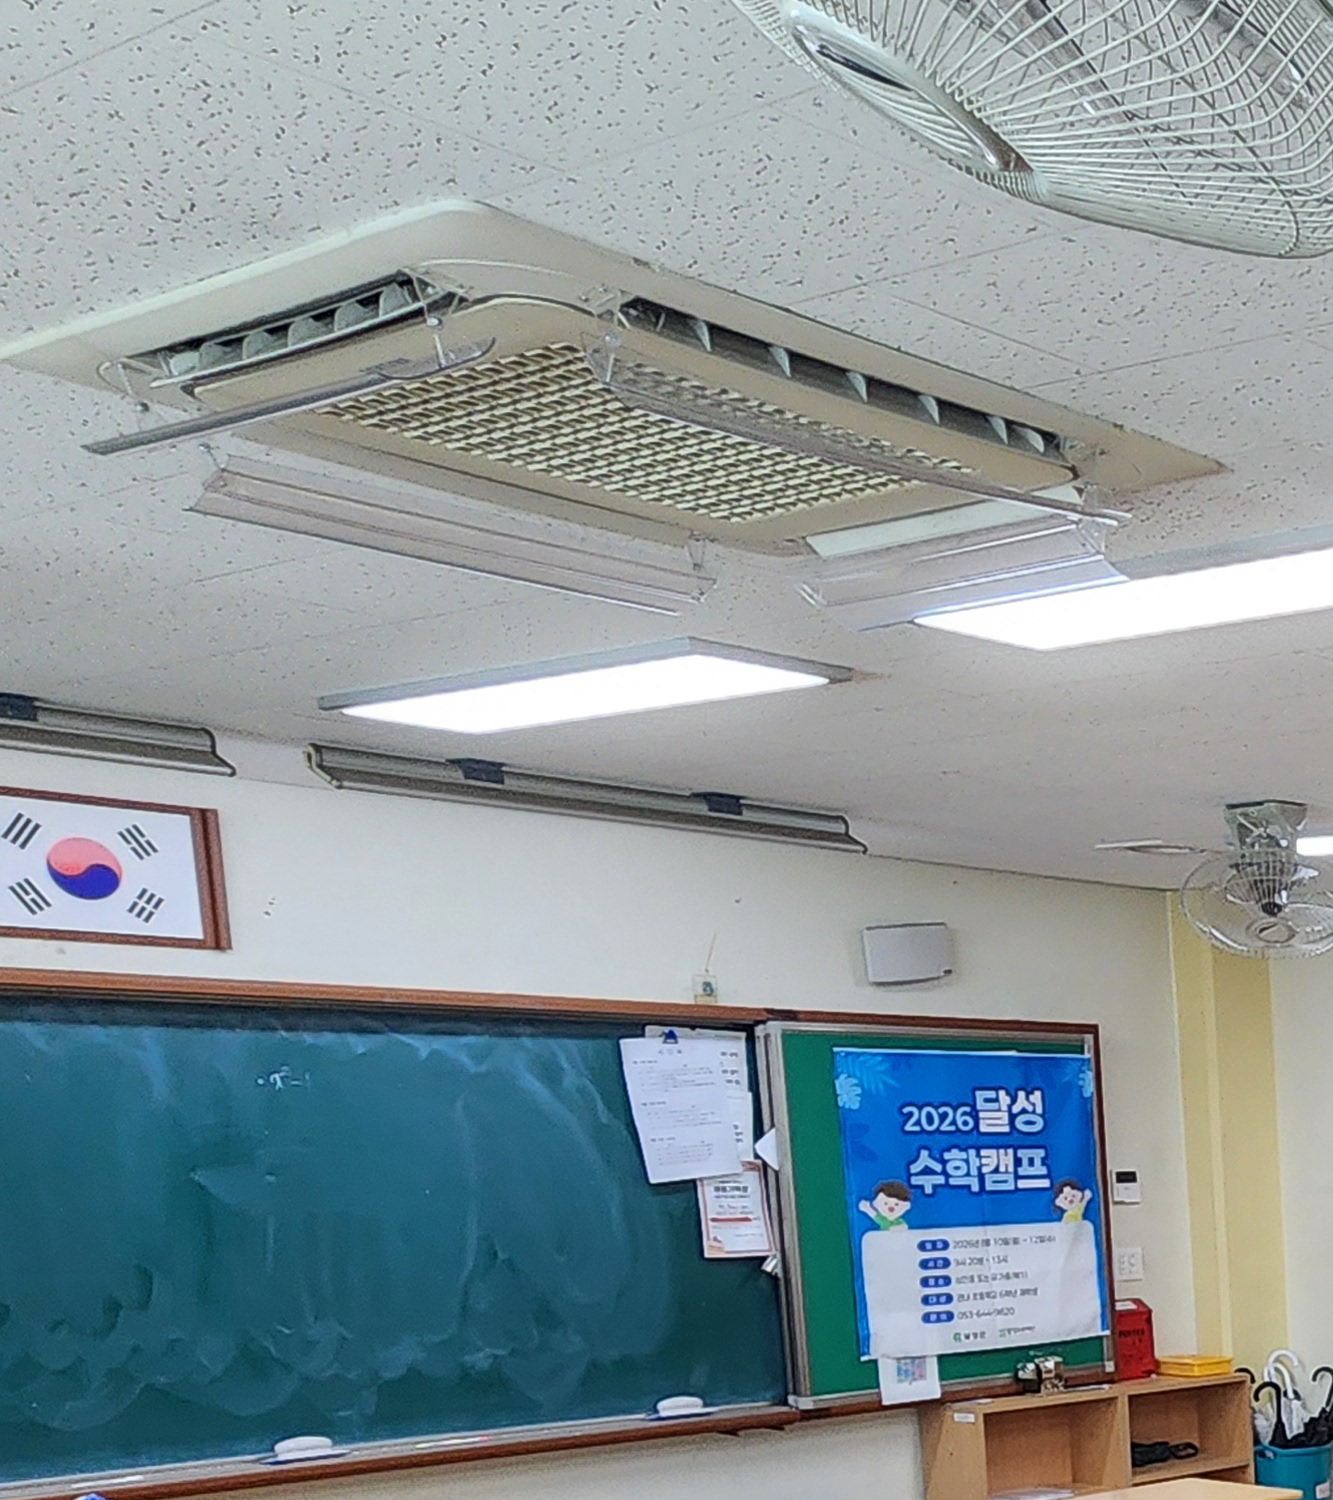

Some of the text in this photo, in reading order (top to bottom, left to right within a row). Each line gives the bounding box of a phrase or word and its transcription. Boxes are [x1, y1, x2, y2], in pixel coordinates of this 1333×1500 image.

[901, 1088, 1045, 1134] 2026 달성
[909, 1147, 1051, 1195] 수학캠프
